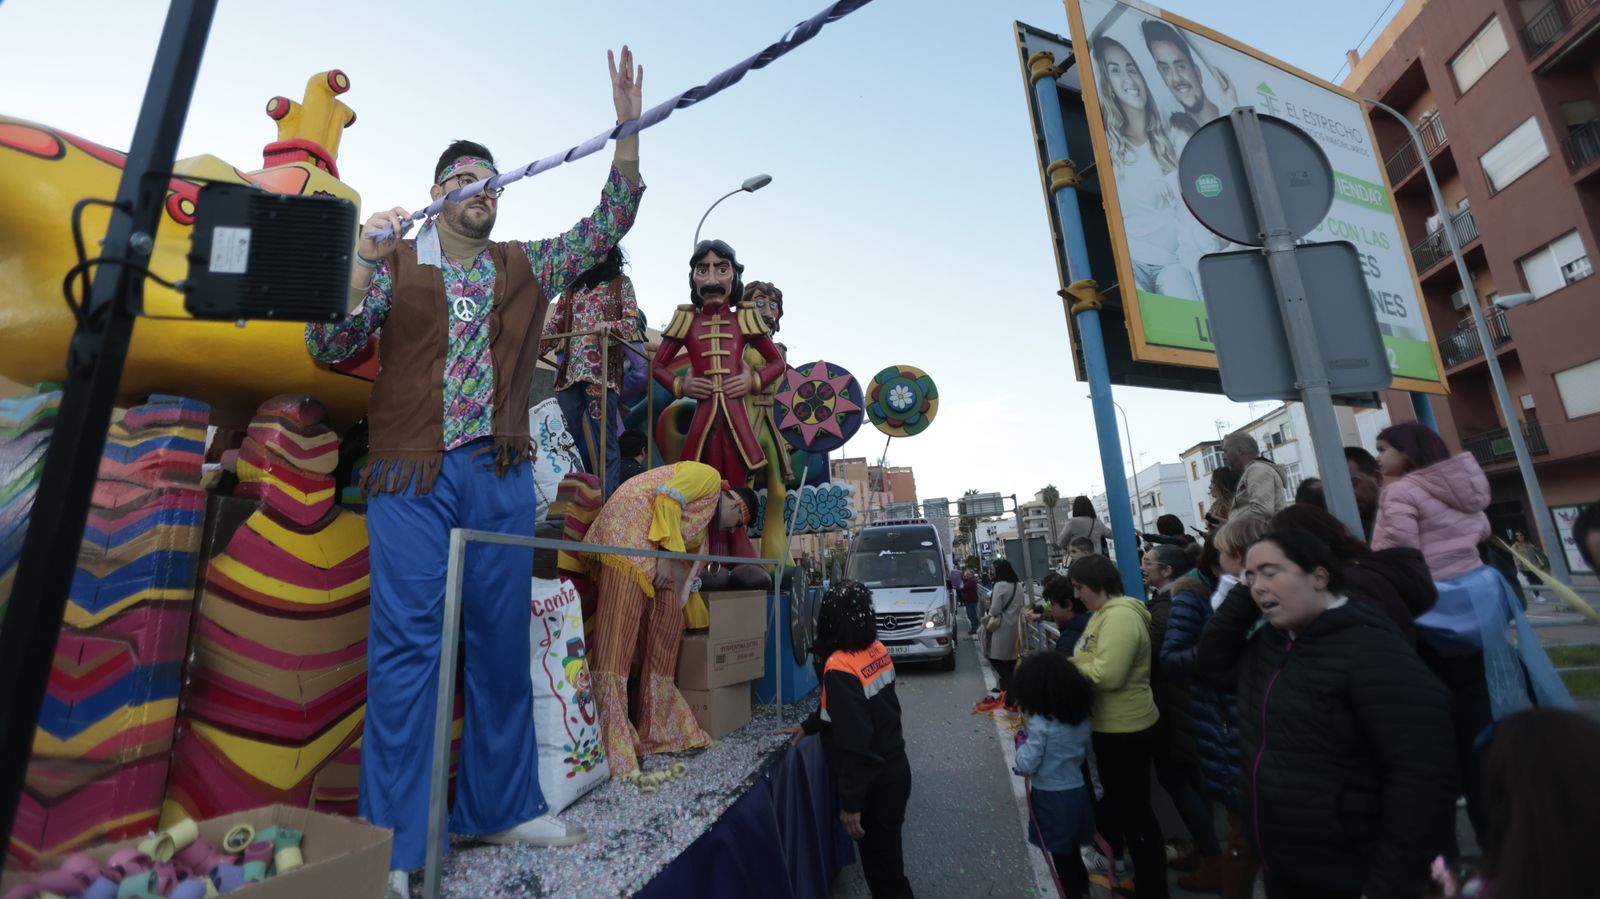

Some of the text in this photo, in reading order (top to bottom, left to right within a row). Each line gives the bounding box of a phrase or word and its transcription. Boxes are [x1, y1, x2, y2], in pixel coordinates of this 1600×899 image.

[1285, 101, 1301, 121] EL
[1302, 108, 1363, 144] ESTRECHO
[1335, 177, 1382, 206] IENDA?
[1328, 216, 1391, 250] CON LAS
[1358, 253, 1382, 279] ES
[1369, 288, 1408, 318] NES
[531, 587, 580, 617] Confe
